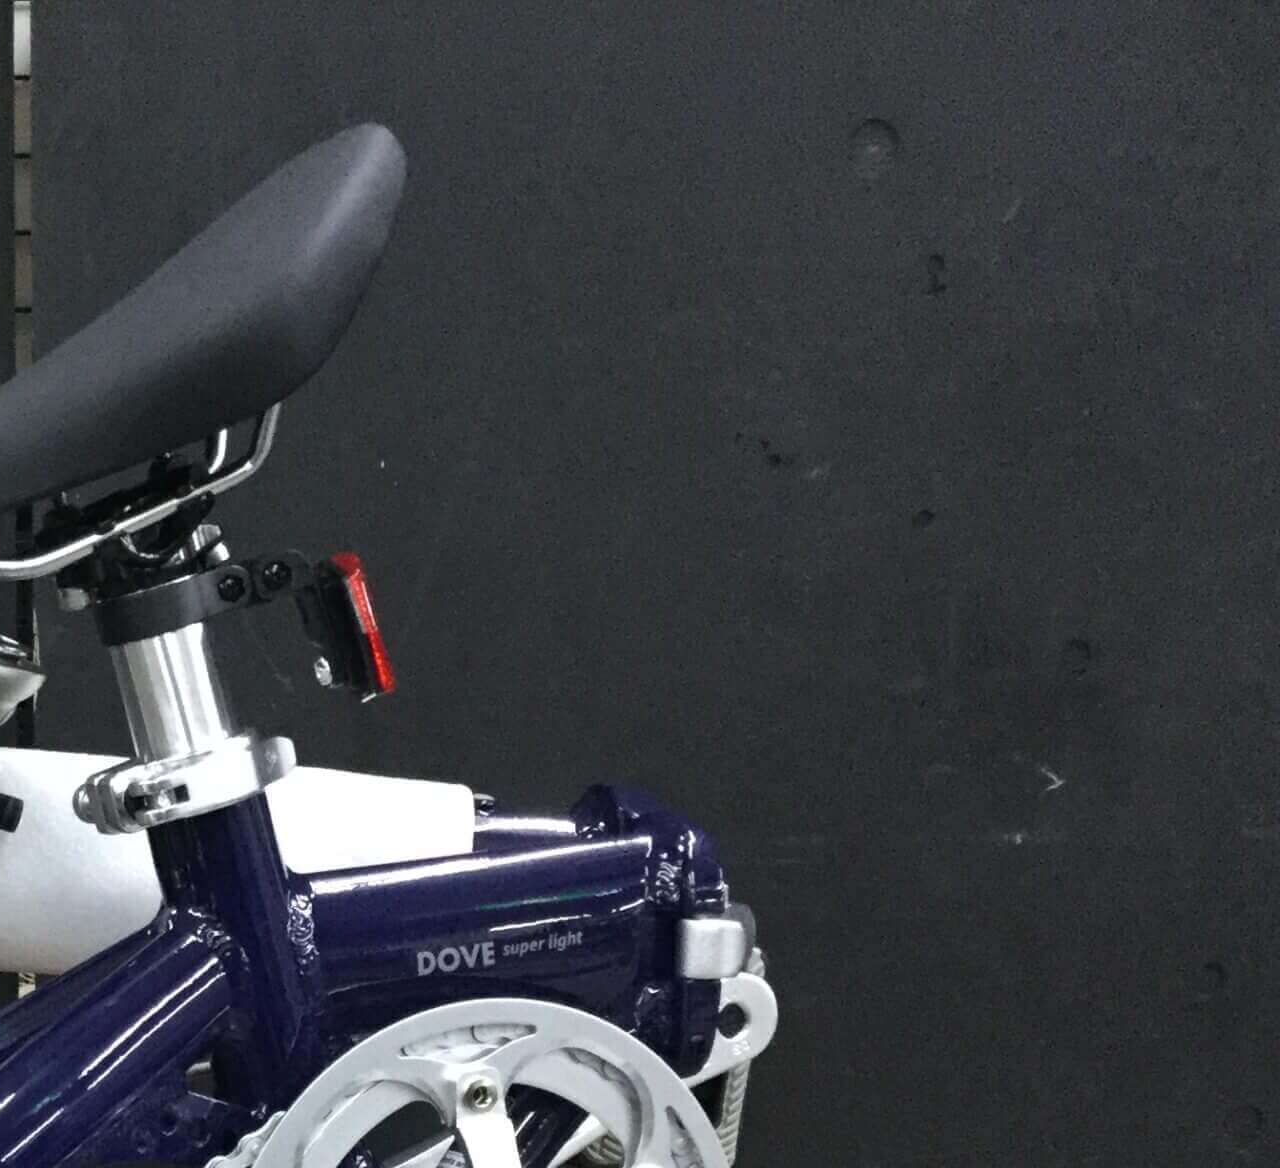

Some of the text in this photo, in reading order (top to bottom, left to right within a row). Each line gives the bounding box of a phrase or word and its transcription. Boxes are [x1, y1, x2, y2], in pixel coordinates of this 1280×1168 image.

[417, 931, 584, 977] DOVE super light
